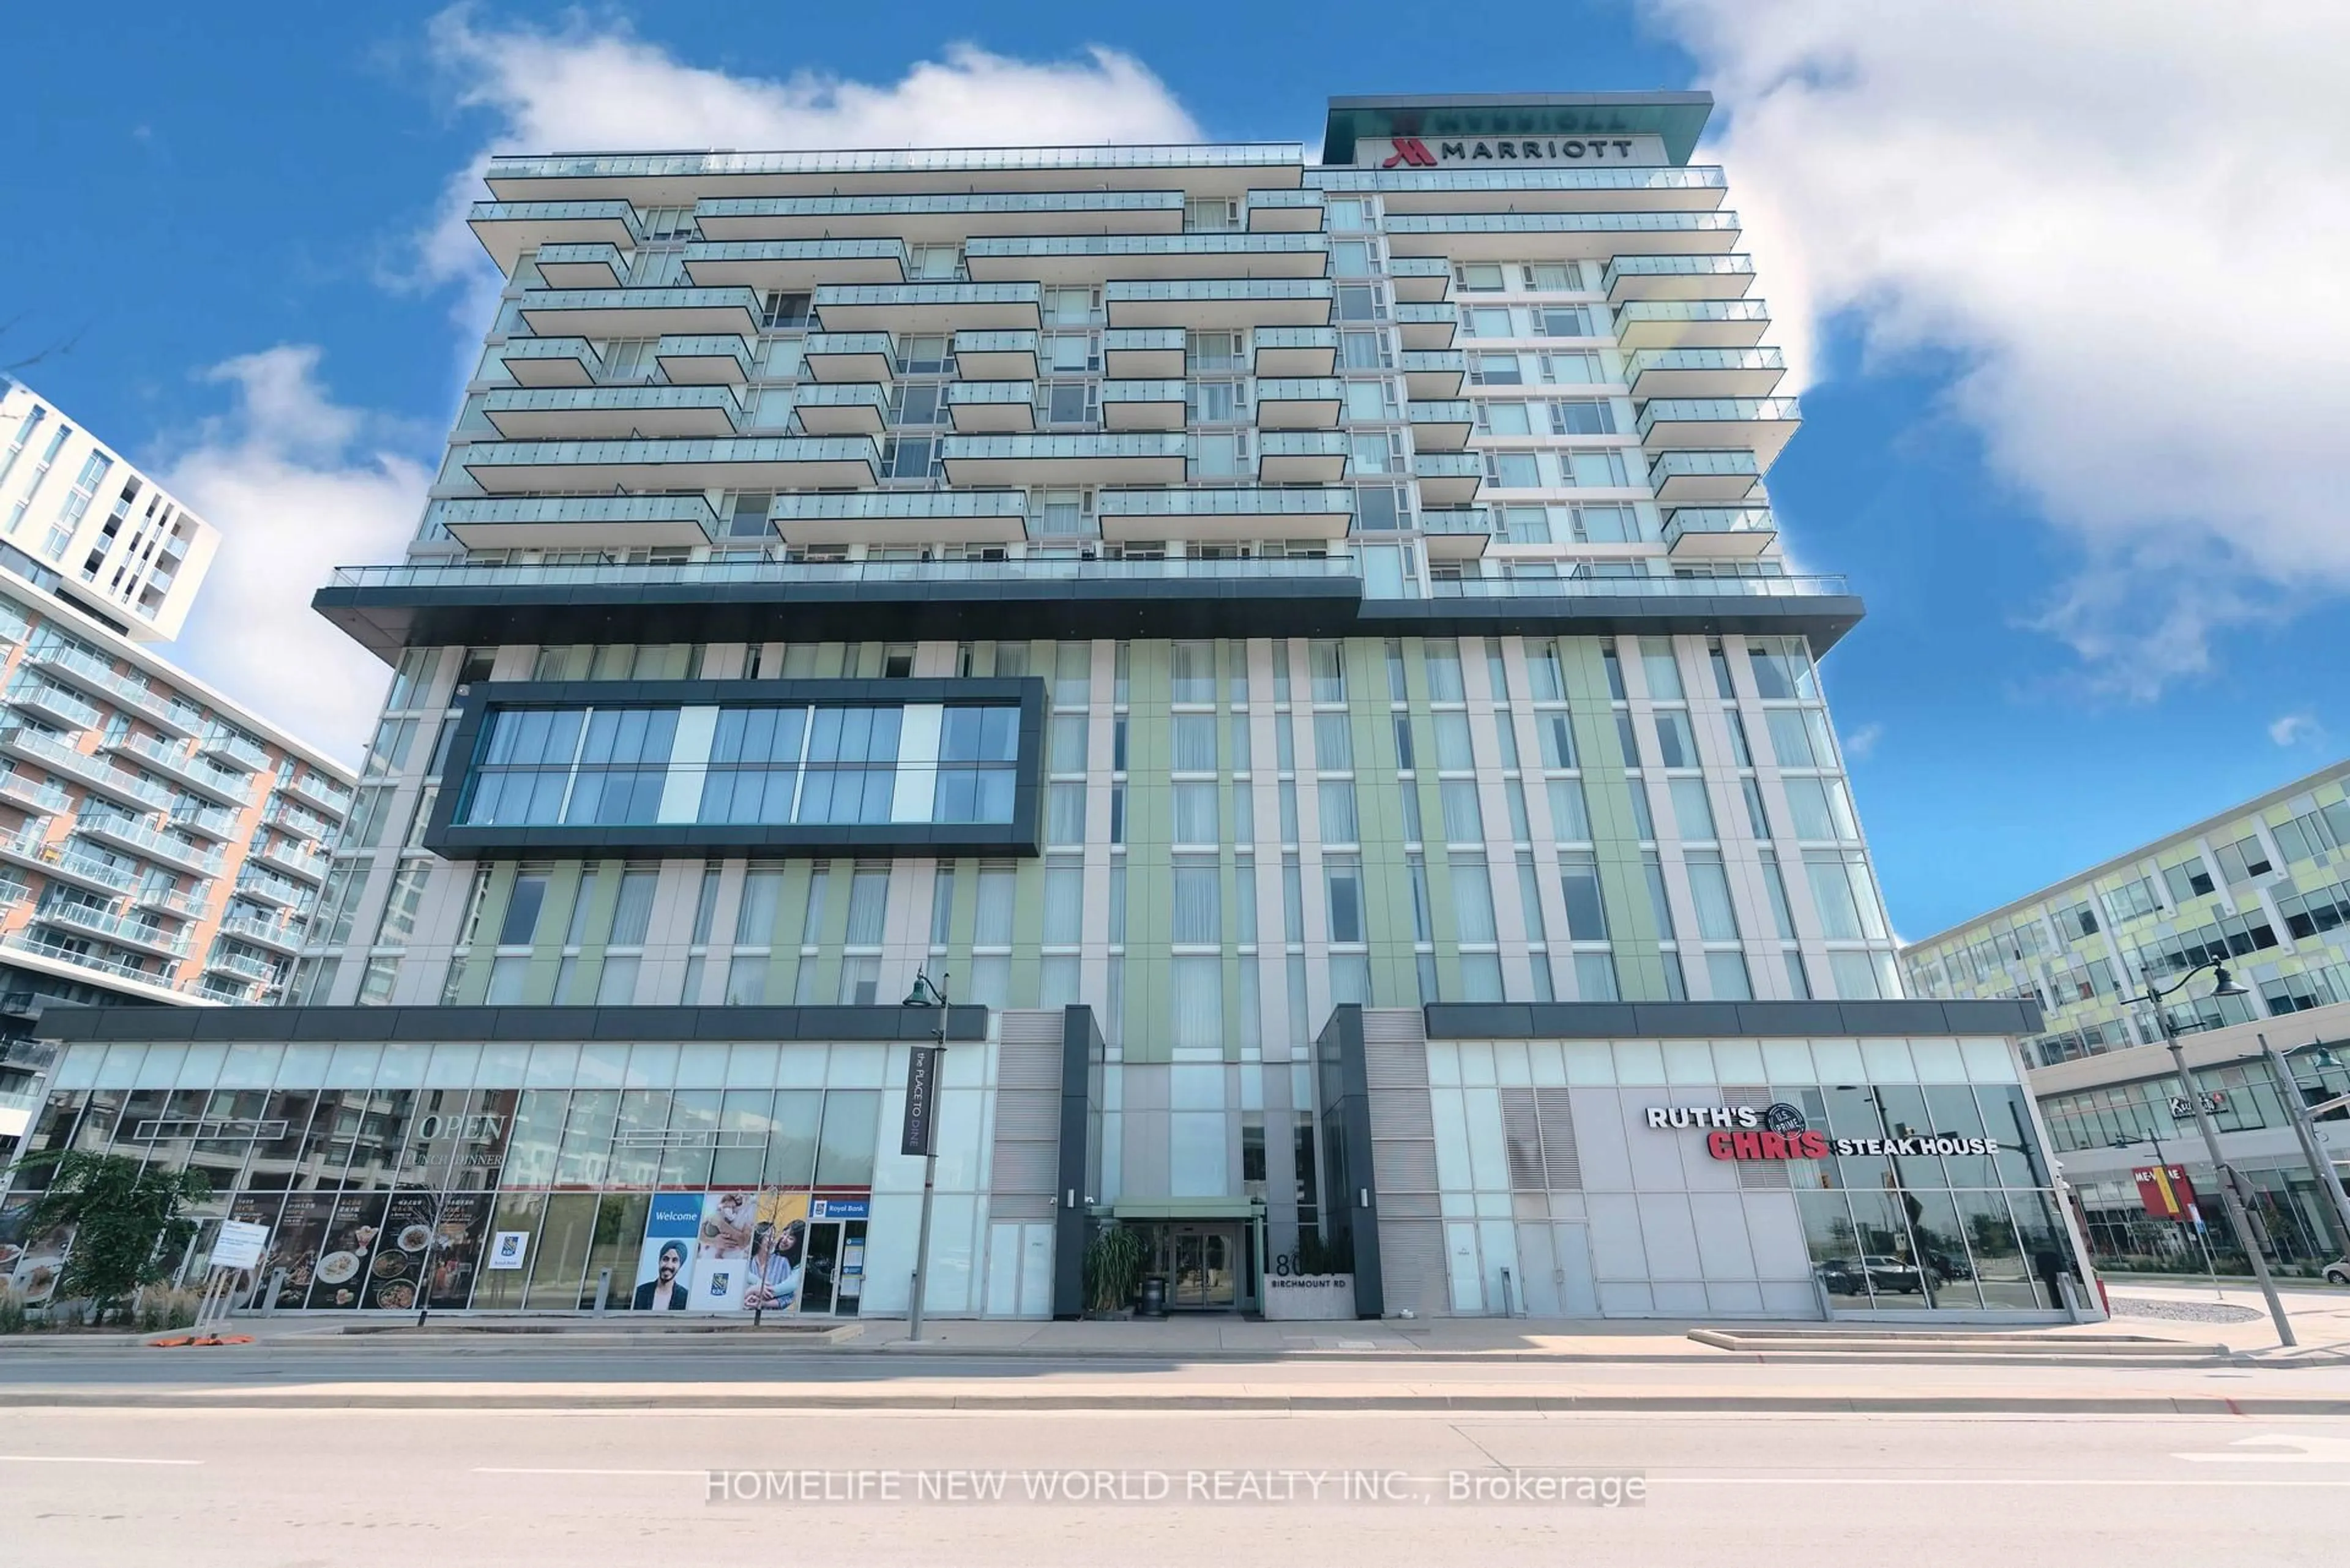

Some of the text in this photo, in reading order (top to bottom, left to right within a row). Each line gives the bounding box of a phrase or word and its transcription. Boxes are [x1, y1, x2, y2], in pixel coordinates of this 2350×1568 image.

[1441, 140, 1633, 160] MARRIOTT
[909, 1053, 925, 1146] the PLACE TO DINE
[419, 1114, 509, 1140] OPEN
[1646, 1107, 1758, 1128] RUTH'S
[1776, 1118, 1800, 1132] PRIME
[1707, 1130, 1829, 1160] CHRIS
[1837, 1138, 2000, 1155] STEAK HOUSE
[403, 1154, 502, 1165] LUNCH DINNER
[656, 1211, 697, 1221] Welcome
